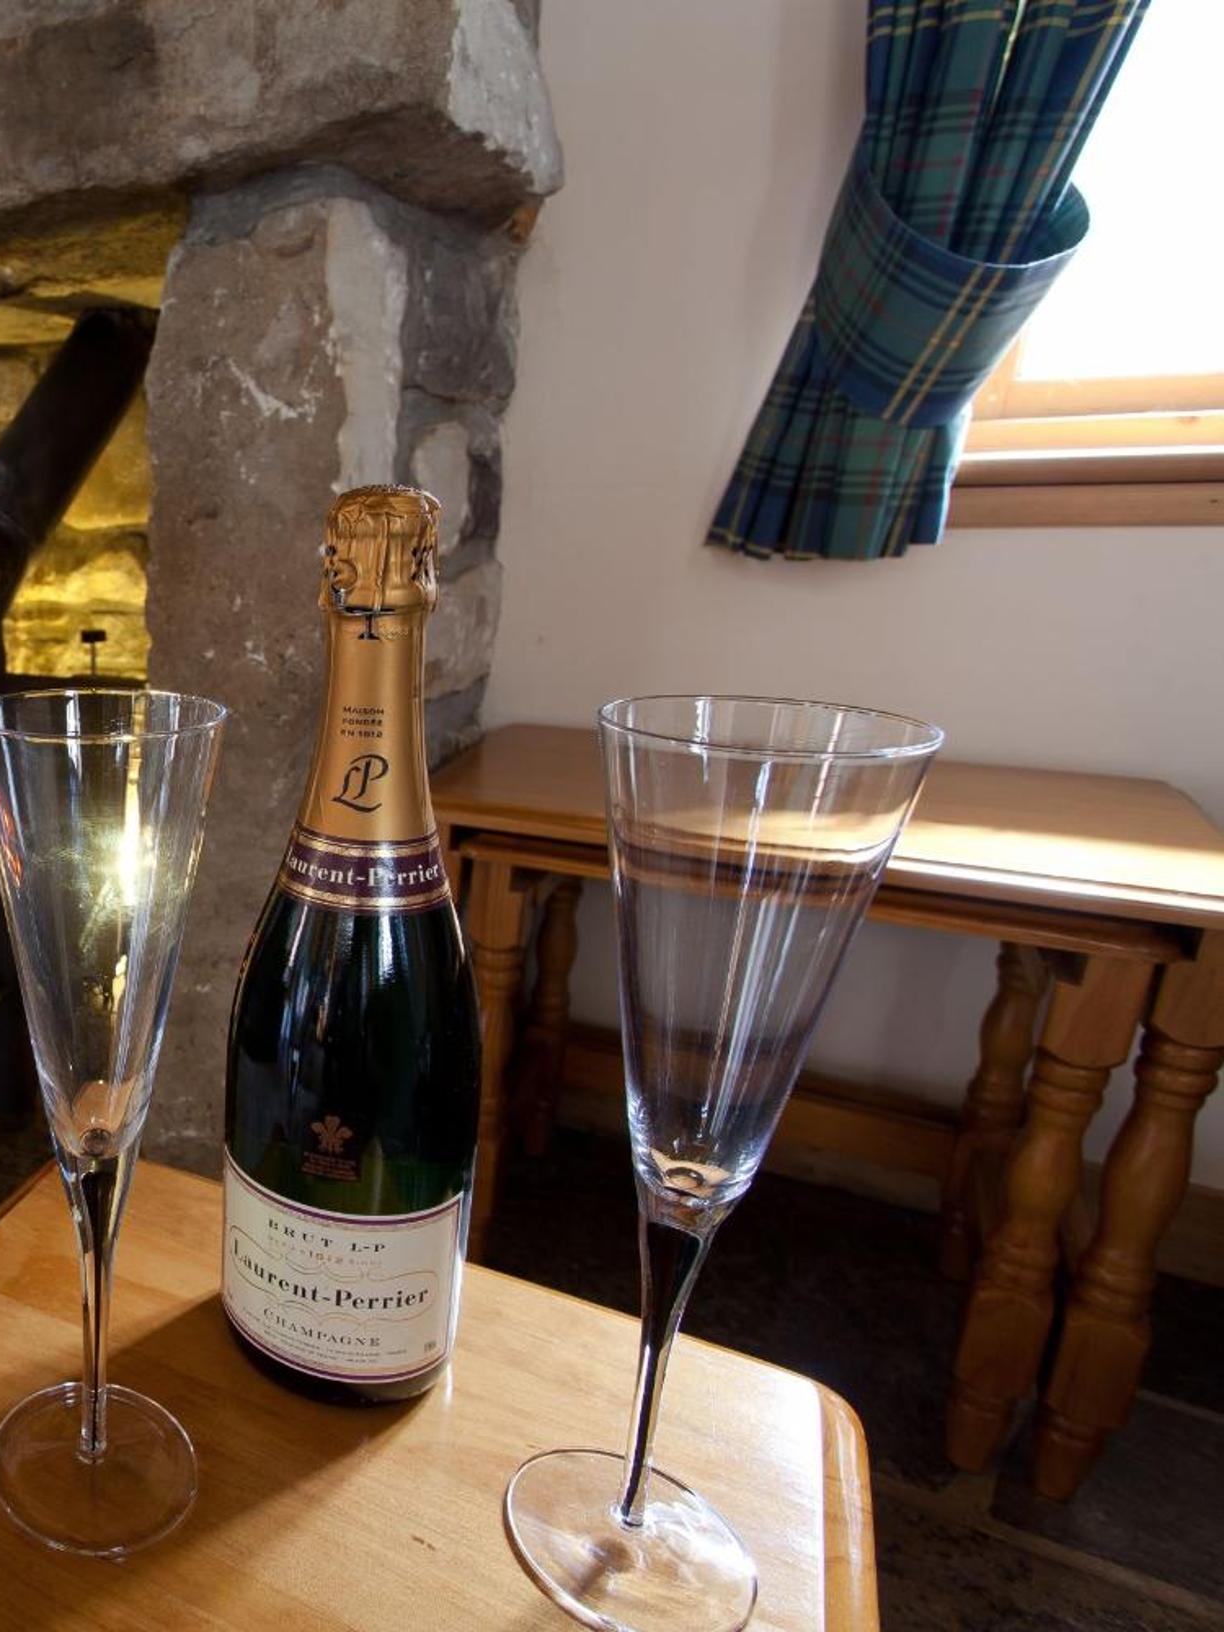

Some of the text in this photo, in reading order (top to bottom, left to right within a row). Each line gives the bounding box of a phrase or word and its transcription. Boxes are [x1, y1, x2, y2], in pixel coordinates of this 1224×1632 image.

[268, 1219, 333, 1248] BRUT
[351, 1242, 386, 1253] L-P
[234, 1238, 429, 1310] Laurent-Perrier
[263, 1306, 381, 1347] CHAMPAGNE
